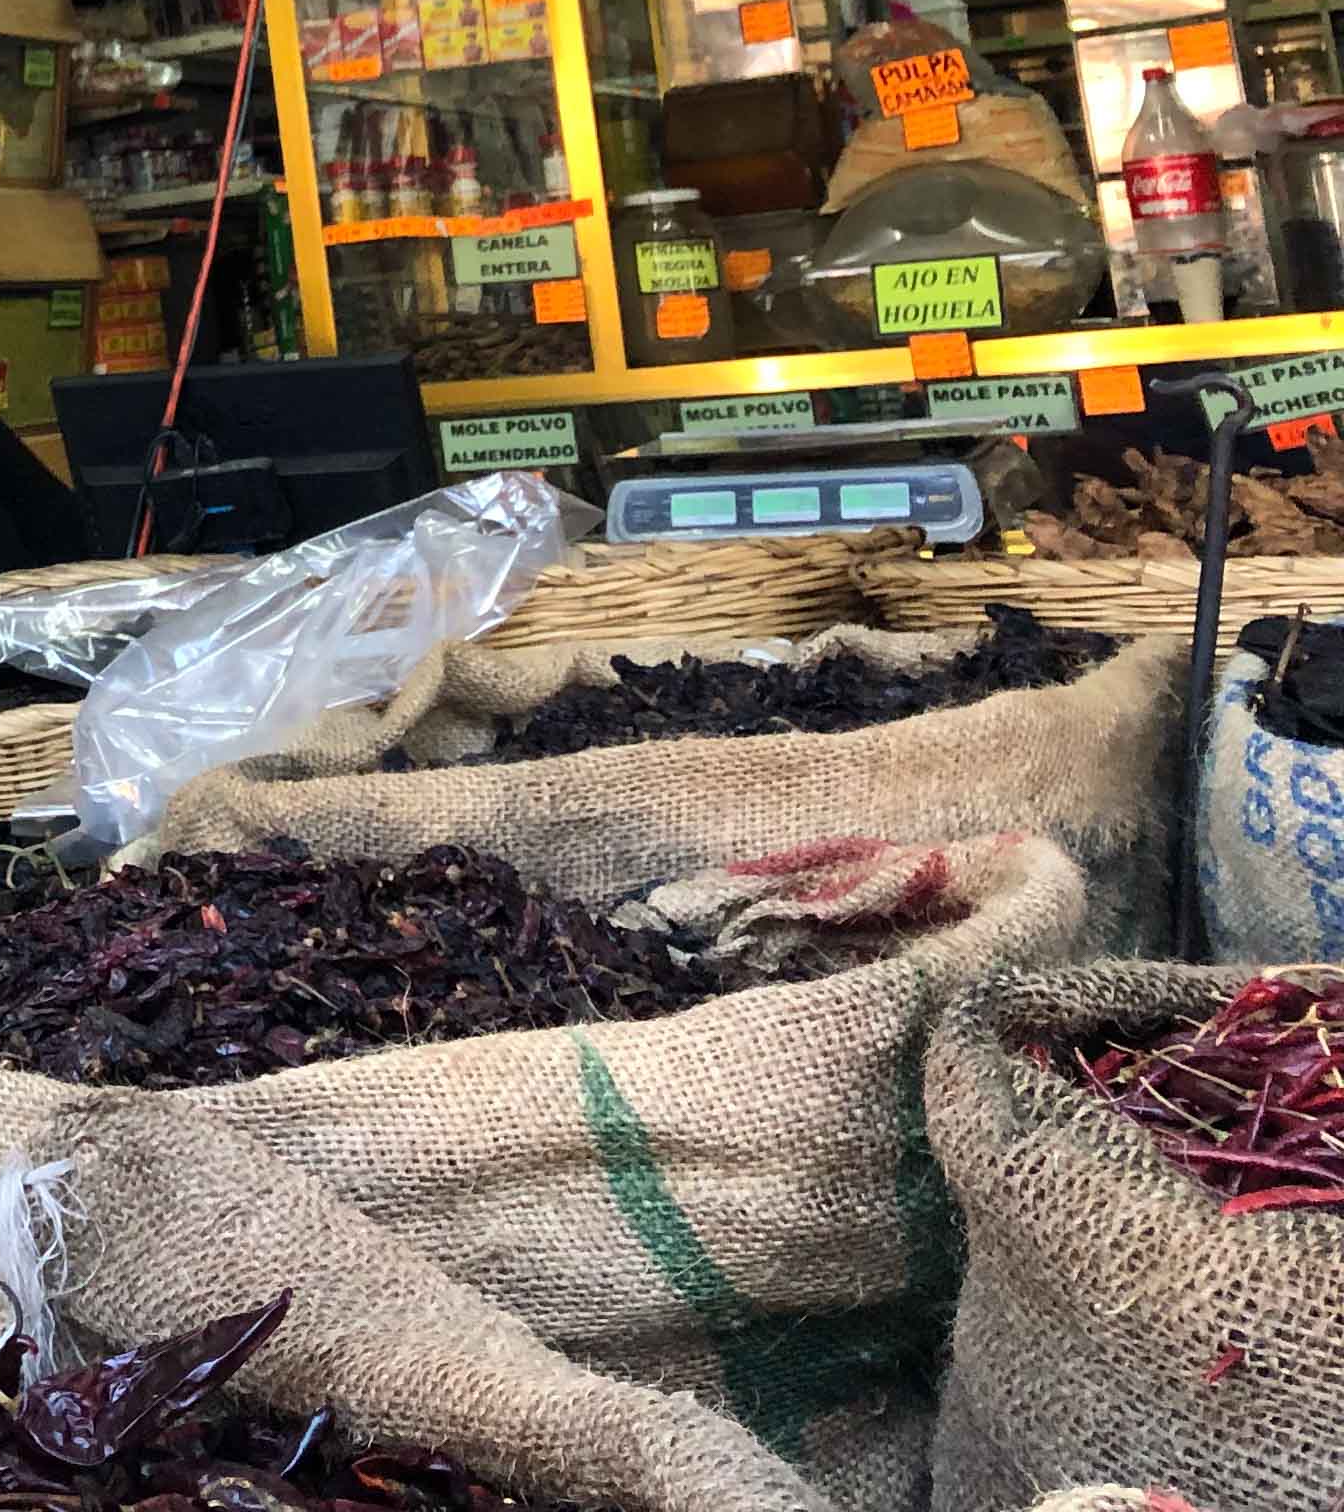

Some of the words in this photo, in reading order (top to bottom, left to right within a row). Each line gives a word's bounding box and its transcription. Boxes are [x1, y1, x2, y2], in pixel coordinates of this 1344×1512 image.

[877, 53, 963, 87] PULPA
[476, 234, 549, 253] CANELA
[479, 259, 552, 277] ENTERA
[892, 267, 939, 290] AJO
[944, 266, 981, 285] EN
[882, 298, 997, 326] HOJUELA
[932, 384, 992, 405] MOLE
[998, 381, 1069, 401] PASTA
[685, 405, 738, 424] MOLE
[743, 398, 812, 418] POLVO
[449, 421, 499, 438] MOLE
[504, 416, 567, 434] POLVO
[450, 443, 576, 466] ALMENDRADO
